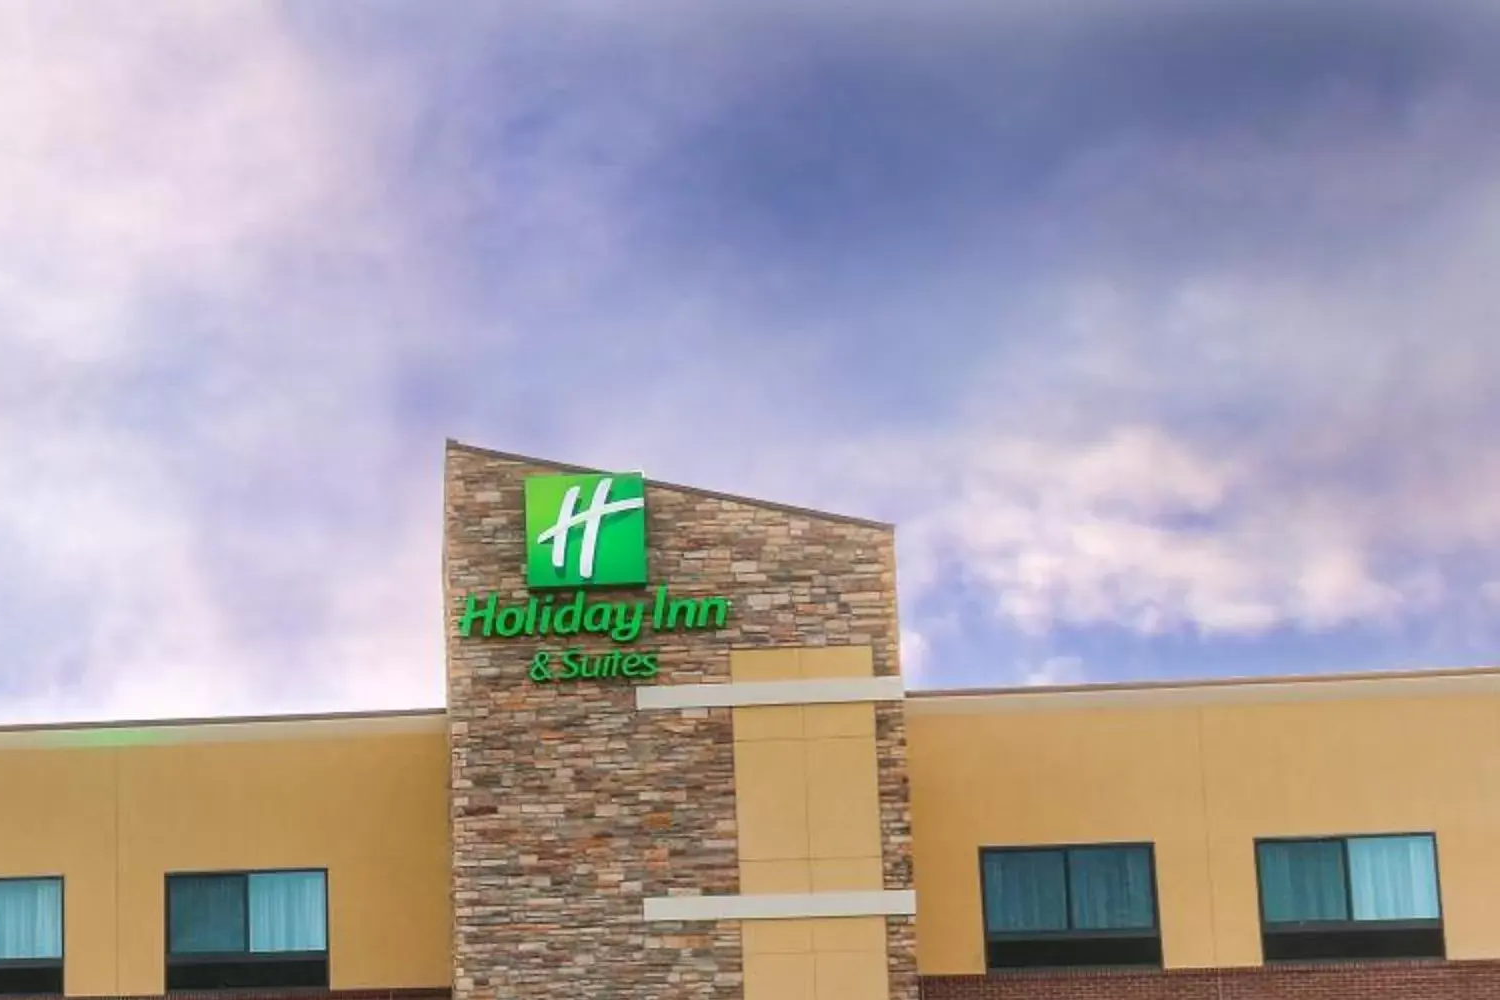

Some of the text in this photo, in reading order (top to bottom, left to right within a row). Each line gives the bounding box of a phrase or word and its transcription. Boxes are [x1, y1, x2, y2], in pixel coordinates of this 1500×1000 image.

[459, 582, 730, 642] Holiday Inn
[529, 648, 660, 681] & Suites
